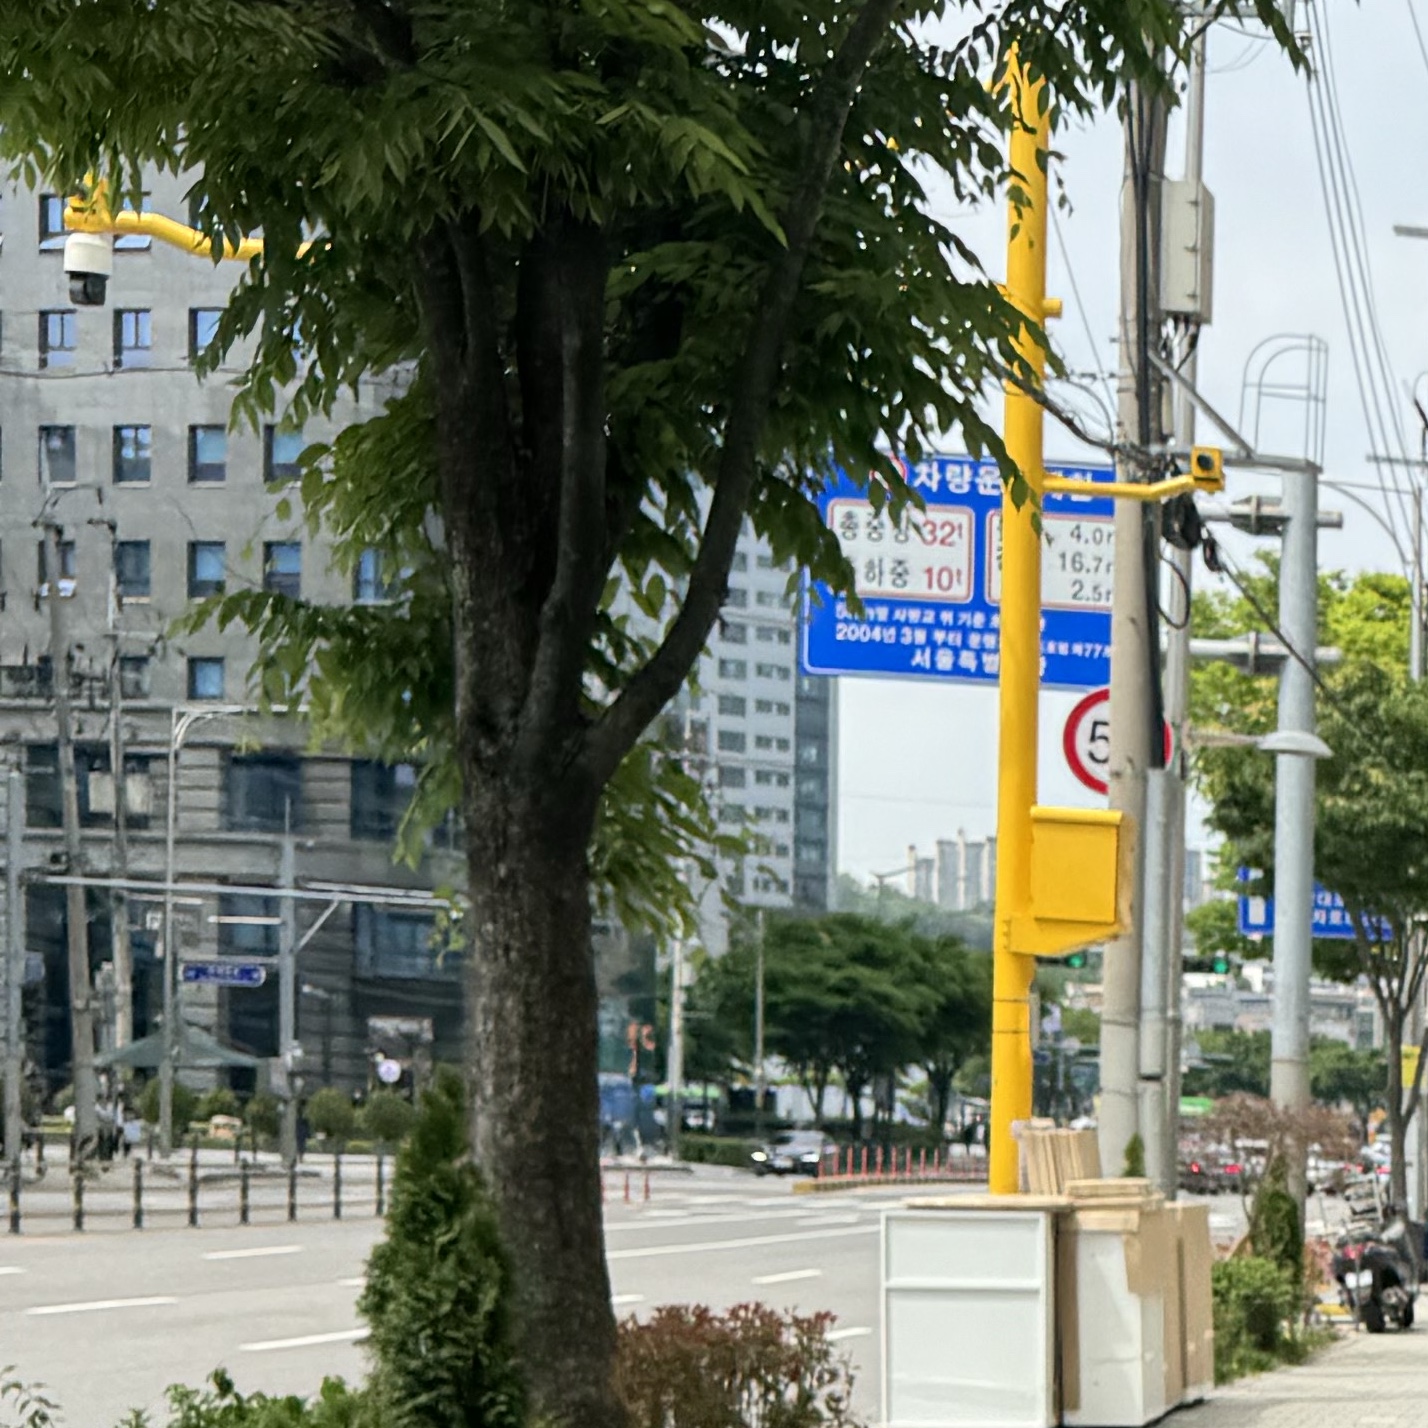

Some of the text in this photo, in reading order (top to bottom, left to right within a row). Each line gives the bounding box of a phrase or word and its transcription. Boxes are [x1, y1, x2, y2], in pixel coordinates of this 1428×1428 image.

[864, 556, 962, 592] 하중 10t
[1087, 719, 1110, 765] 5
